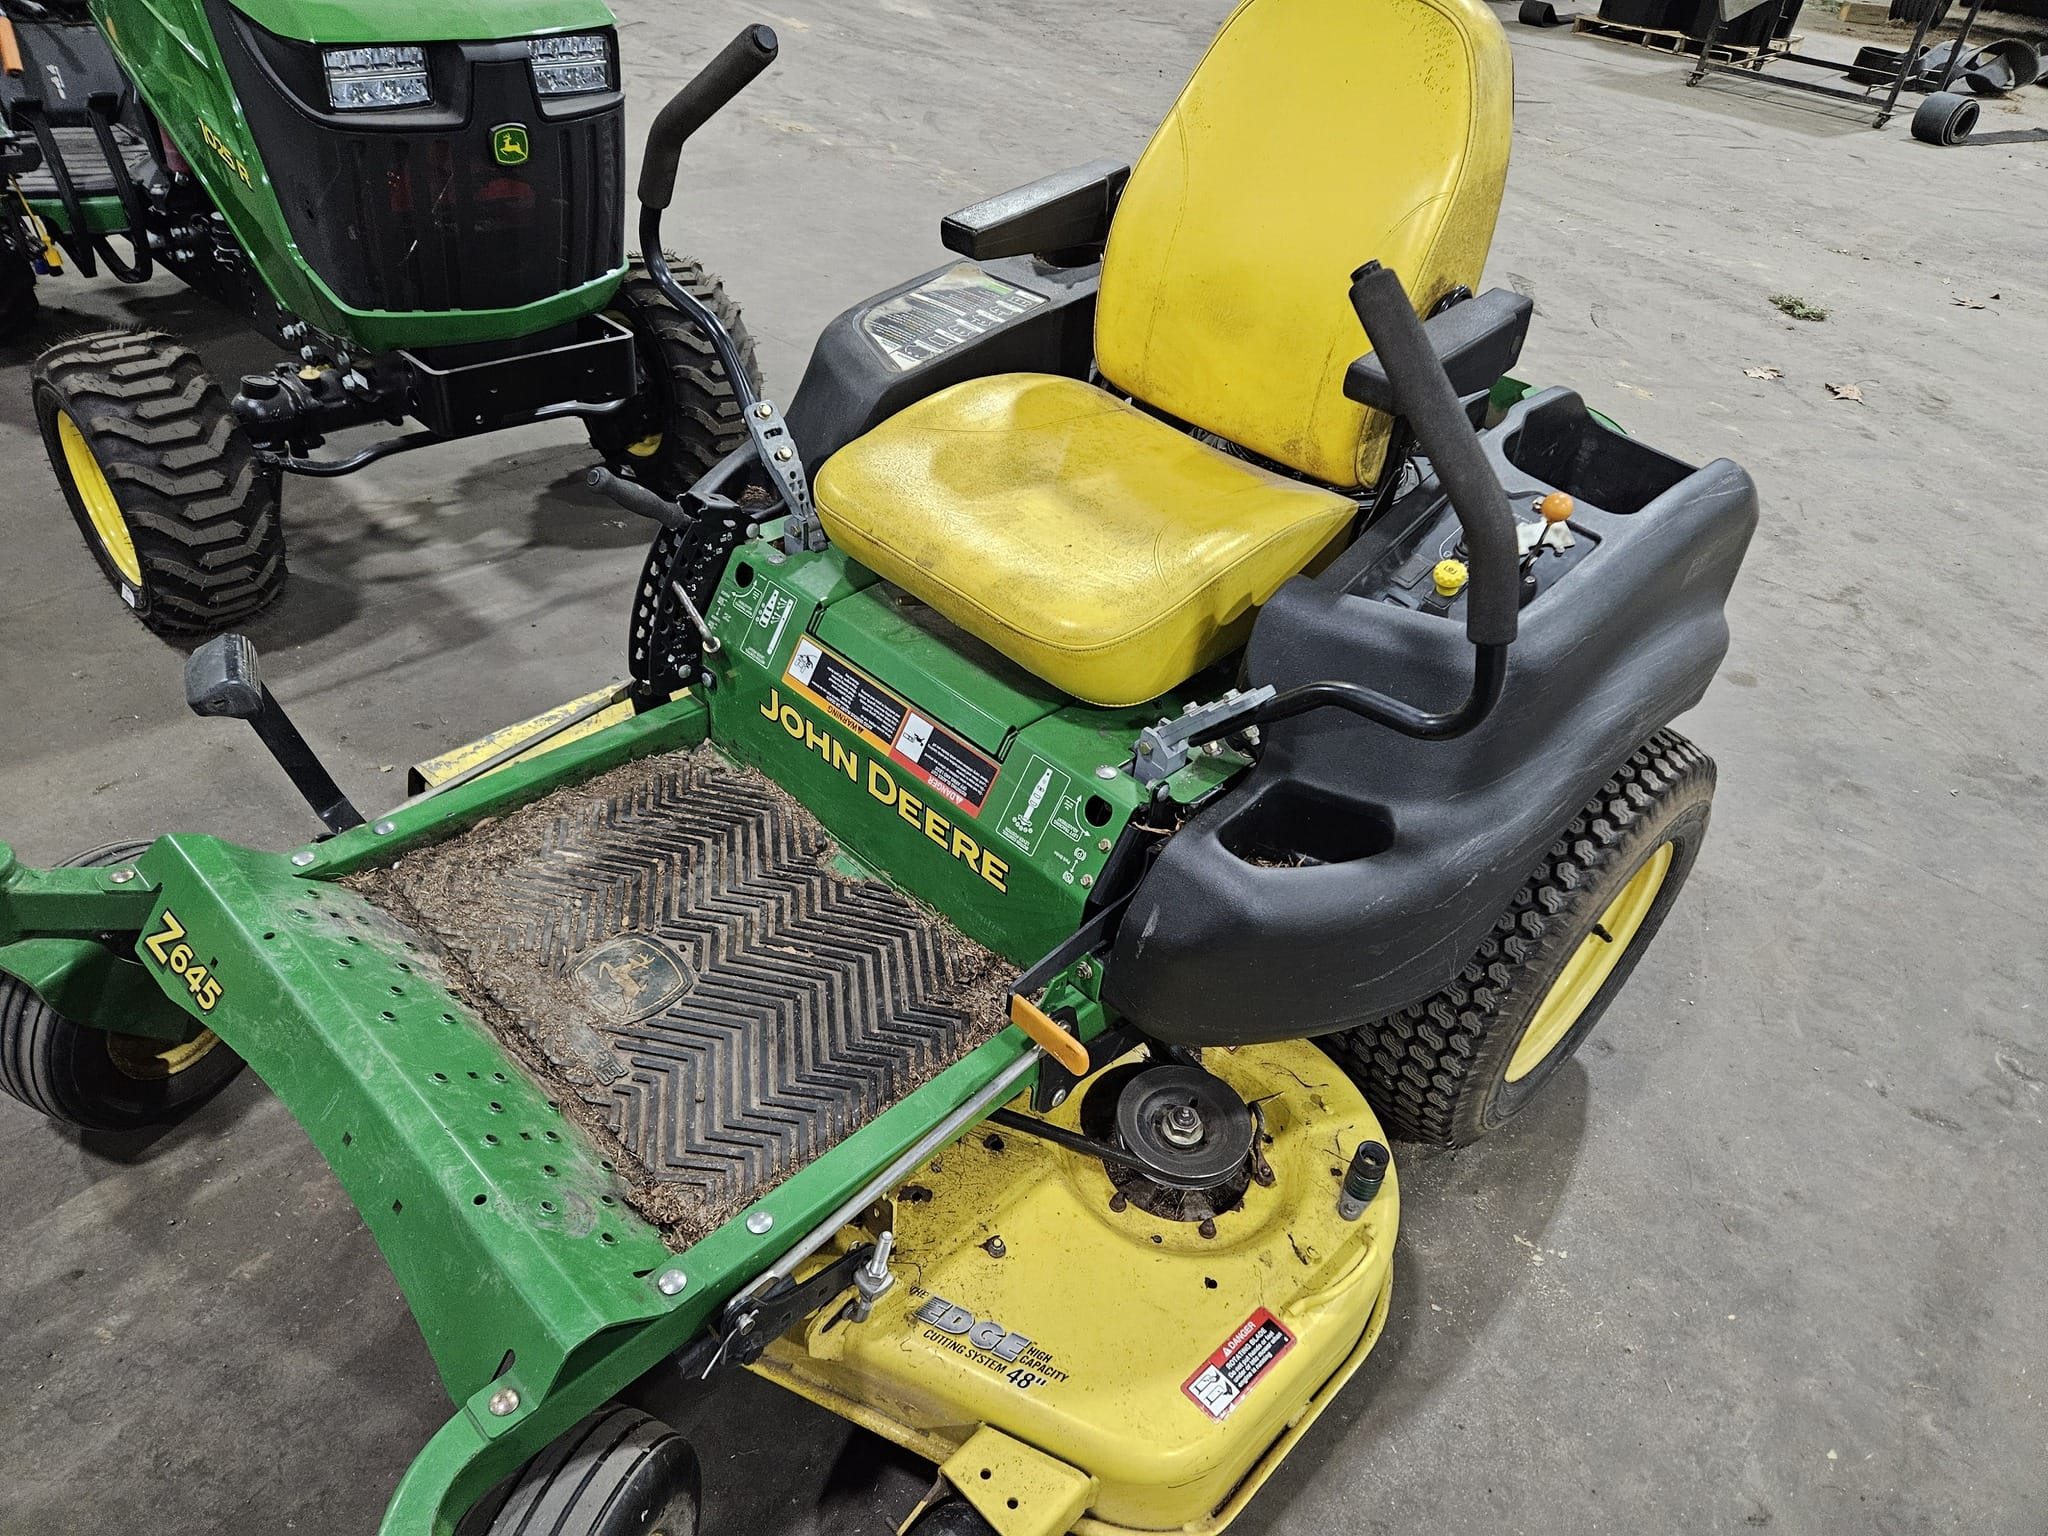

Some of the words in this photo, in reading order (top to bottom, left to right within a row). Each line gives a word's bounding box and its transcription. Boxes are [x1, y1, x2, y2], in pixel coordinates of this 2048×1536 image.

[826, 704, 858, 731] WARNING
[760, 689, 858, 783] JOHN
[867, 761, 1011, 894] DEERE
[926, 775, 956, 800] DANGER
[144, 908, 225, 1014] Z645
[909, 1286, 929, 1299] THE
[912, 1295, 1030, 1363] EDGE
[1227, 1320, 1256, 1349] DANGER
[923, 1329, 966, 1354] CUTTING
[965, 1345, 1007, 1375] SYSTEM
[1005, 1367, 1047, 1390] 48"
[1028, 1346, 1053, 1364] HIGH
[1224, 1342, 1252, 1370] ROTATING
[1248, 1326, 1267, 1346] BLADE
[1227, 1369, 1237, 1379] Do
[1233, 1361, 1244, 1372] not
[1259, 1337, 1267, 1345] or
[1019, 1355, 1070, 1383] CAPACITY
[1243, 1363, 1252, 1371] or
